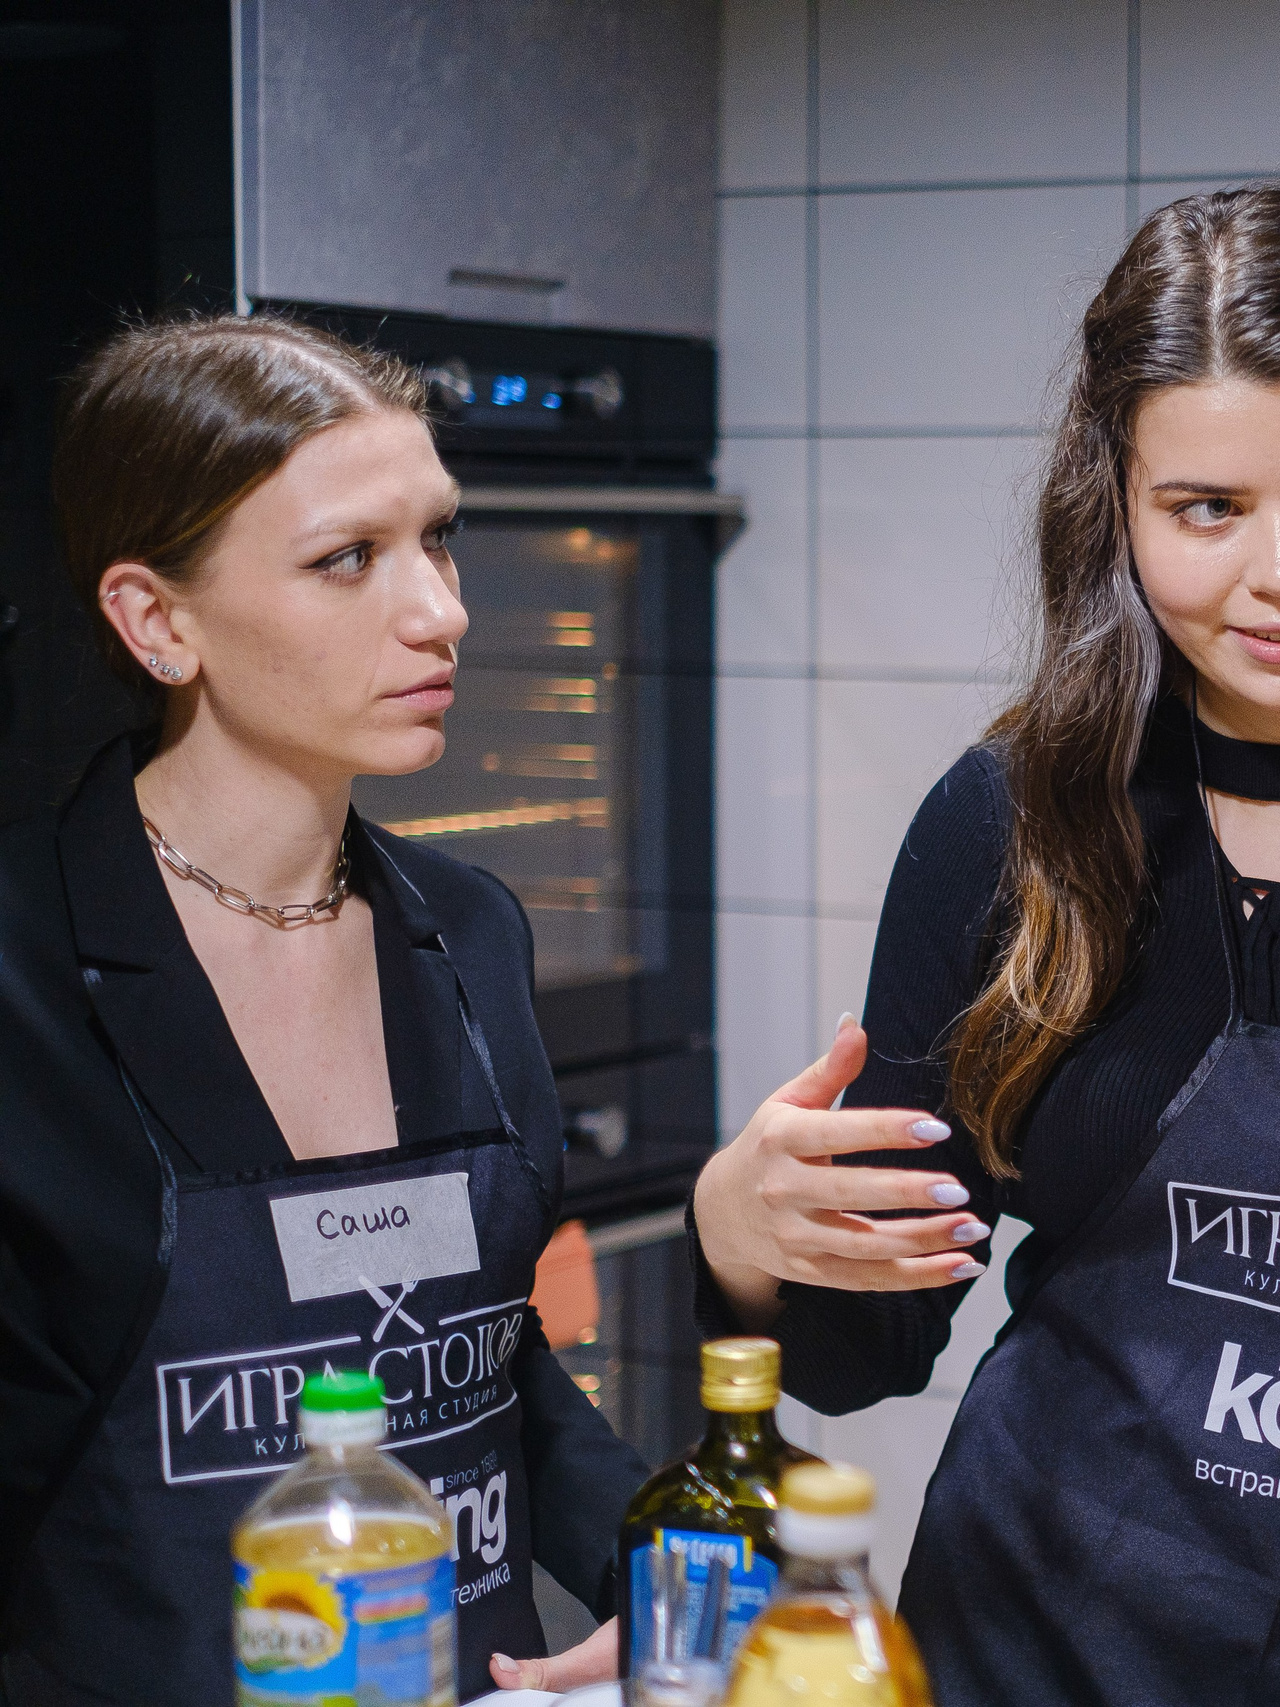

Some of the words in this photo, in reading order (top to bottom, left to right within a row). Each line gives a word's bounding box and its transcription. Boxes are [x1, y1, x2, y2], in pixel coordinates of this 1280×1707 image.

[316, 1203, 412, 1240] Саша
[255, 1409, 429, 1456] КУЛНАЯ
[438, 1384, 498, 1420] СТУДИЯ
[446, 1467, 479, 1489] since
[450, 1562, 511, 1608] техника
